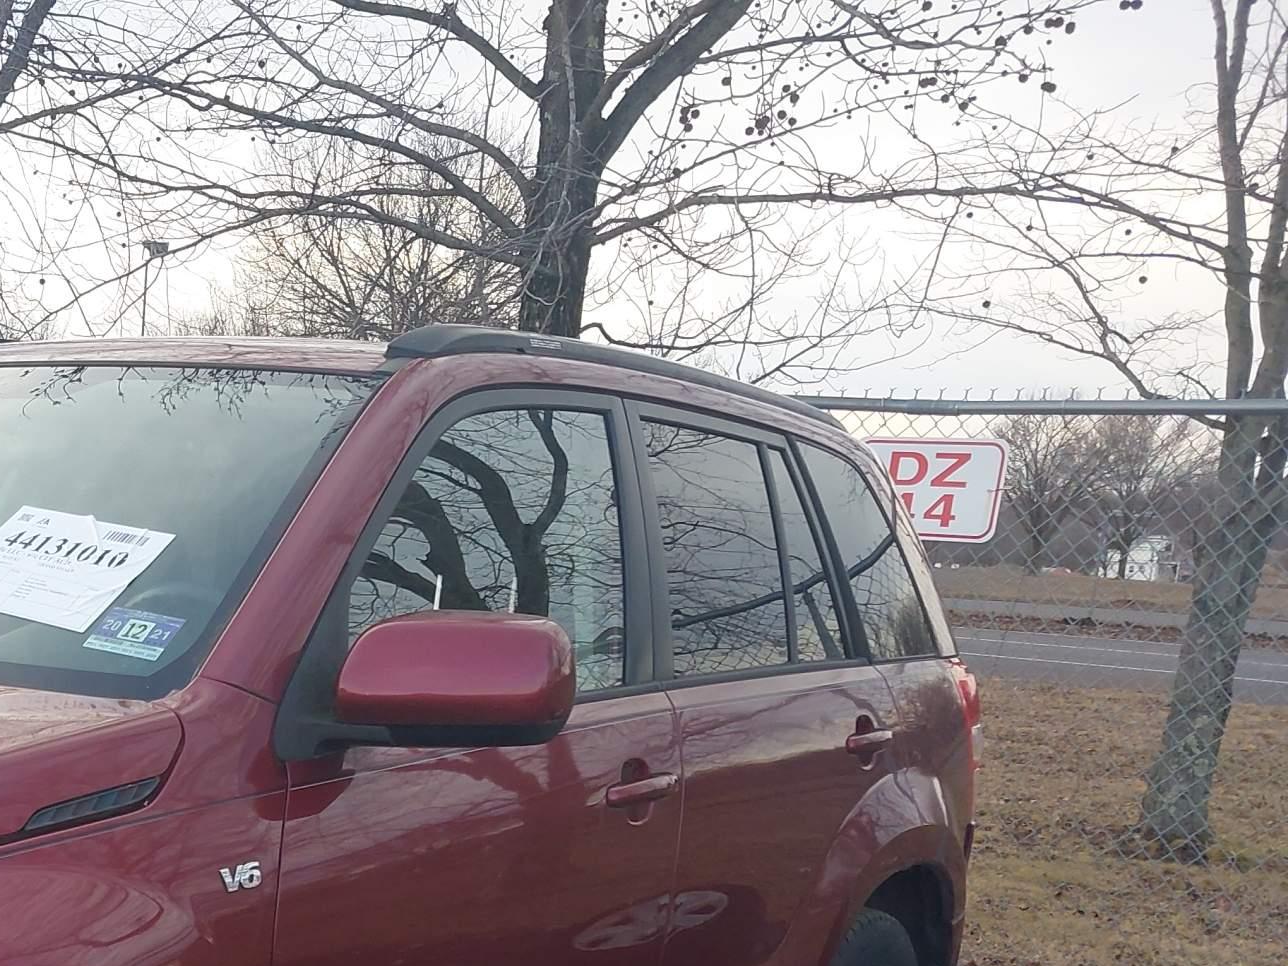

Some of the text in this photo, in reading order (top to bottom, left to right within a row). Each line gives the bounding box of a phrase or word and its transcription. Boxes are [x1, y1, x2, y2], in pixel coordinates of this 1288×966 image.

[889, 451, 972, 488] DZ
[4, 530, 129, 569] 44131010
[102, 619, 171, 641] 20 12 21
[218, 861, 262, 893] V6
